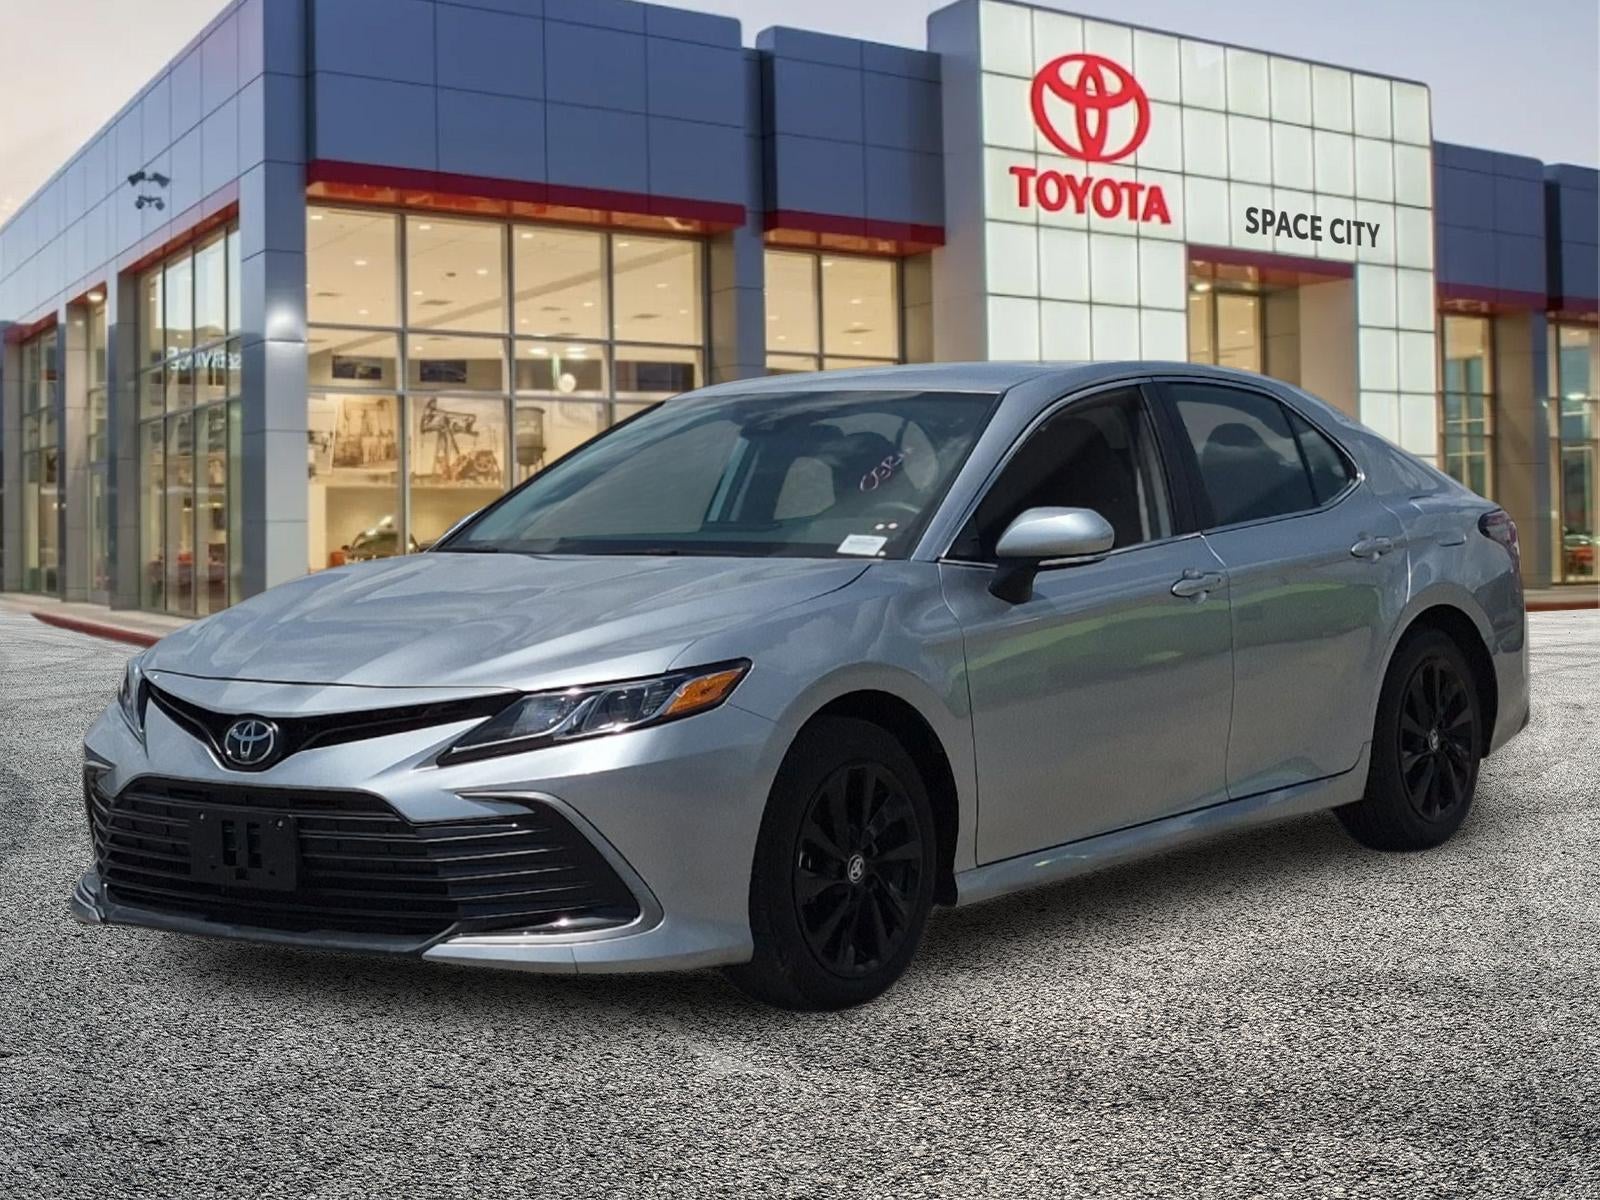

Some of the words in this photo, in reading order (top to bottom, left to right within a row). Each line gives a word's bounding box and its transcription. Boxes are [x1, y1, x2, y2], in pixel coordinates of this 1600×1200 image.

[1009, 166, 1171, 224] TOYOTA
[1245, 206, 1322, 241] SPACE
[1329, 217, 1381, 247] CITY
